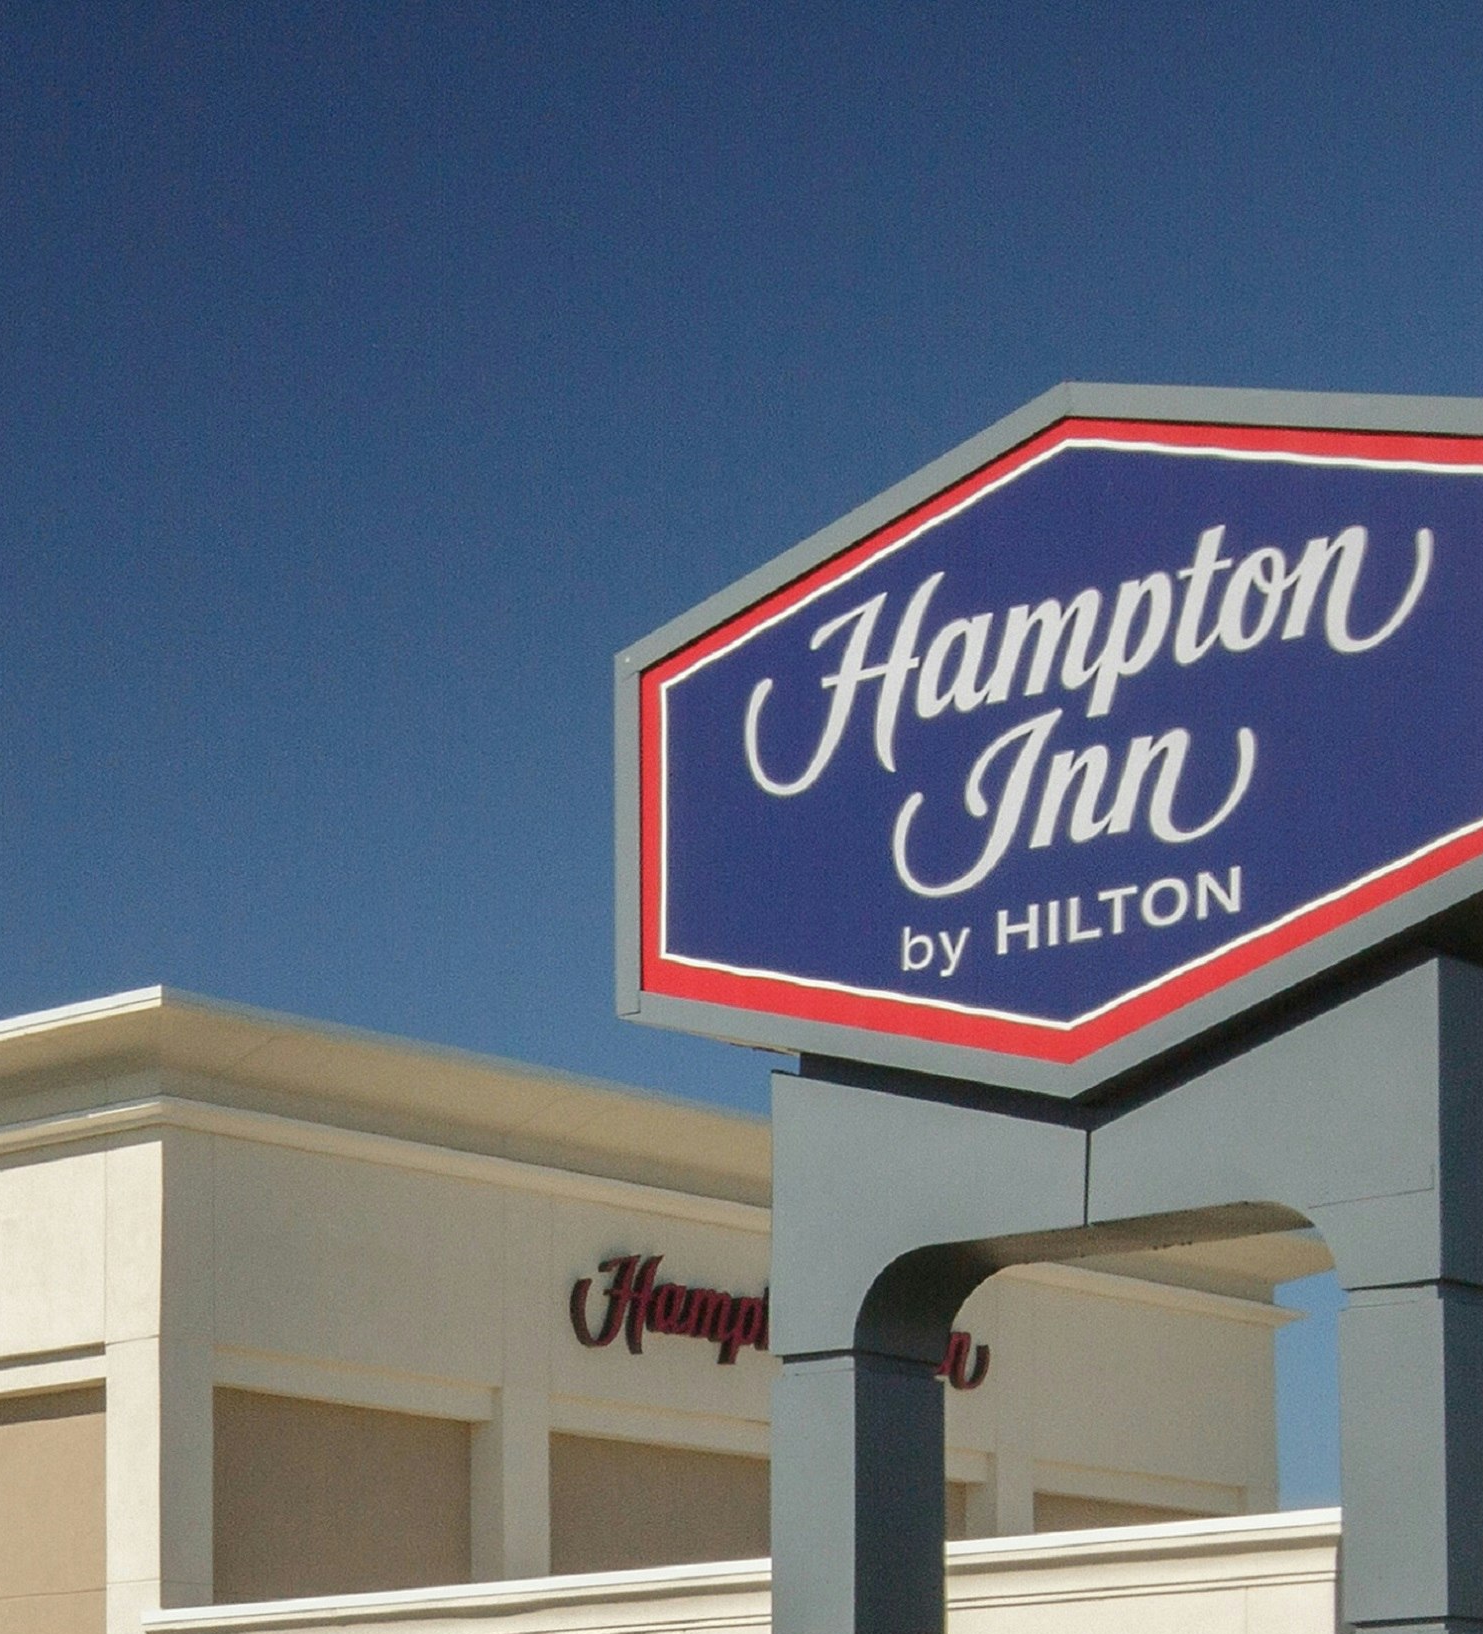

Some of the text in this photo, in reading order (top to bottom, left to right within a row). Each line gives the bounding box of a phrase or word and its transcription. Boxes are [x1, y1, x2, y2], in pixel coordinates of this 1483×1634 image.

[743, 523, 1435, 797] Hampton
[891, 707, 1257, 898] Inn
[900, 865, 1242, 978] by HILTON
[569, 1254, 770, 1366] Hamp
